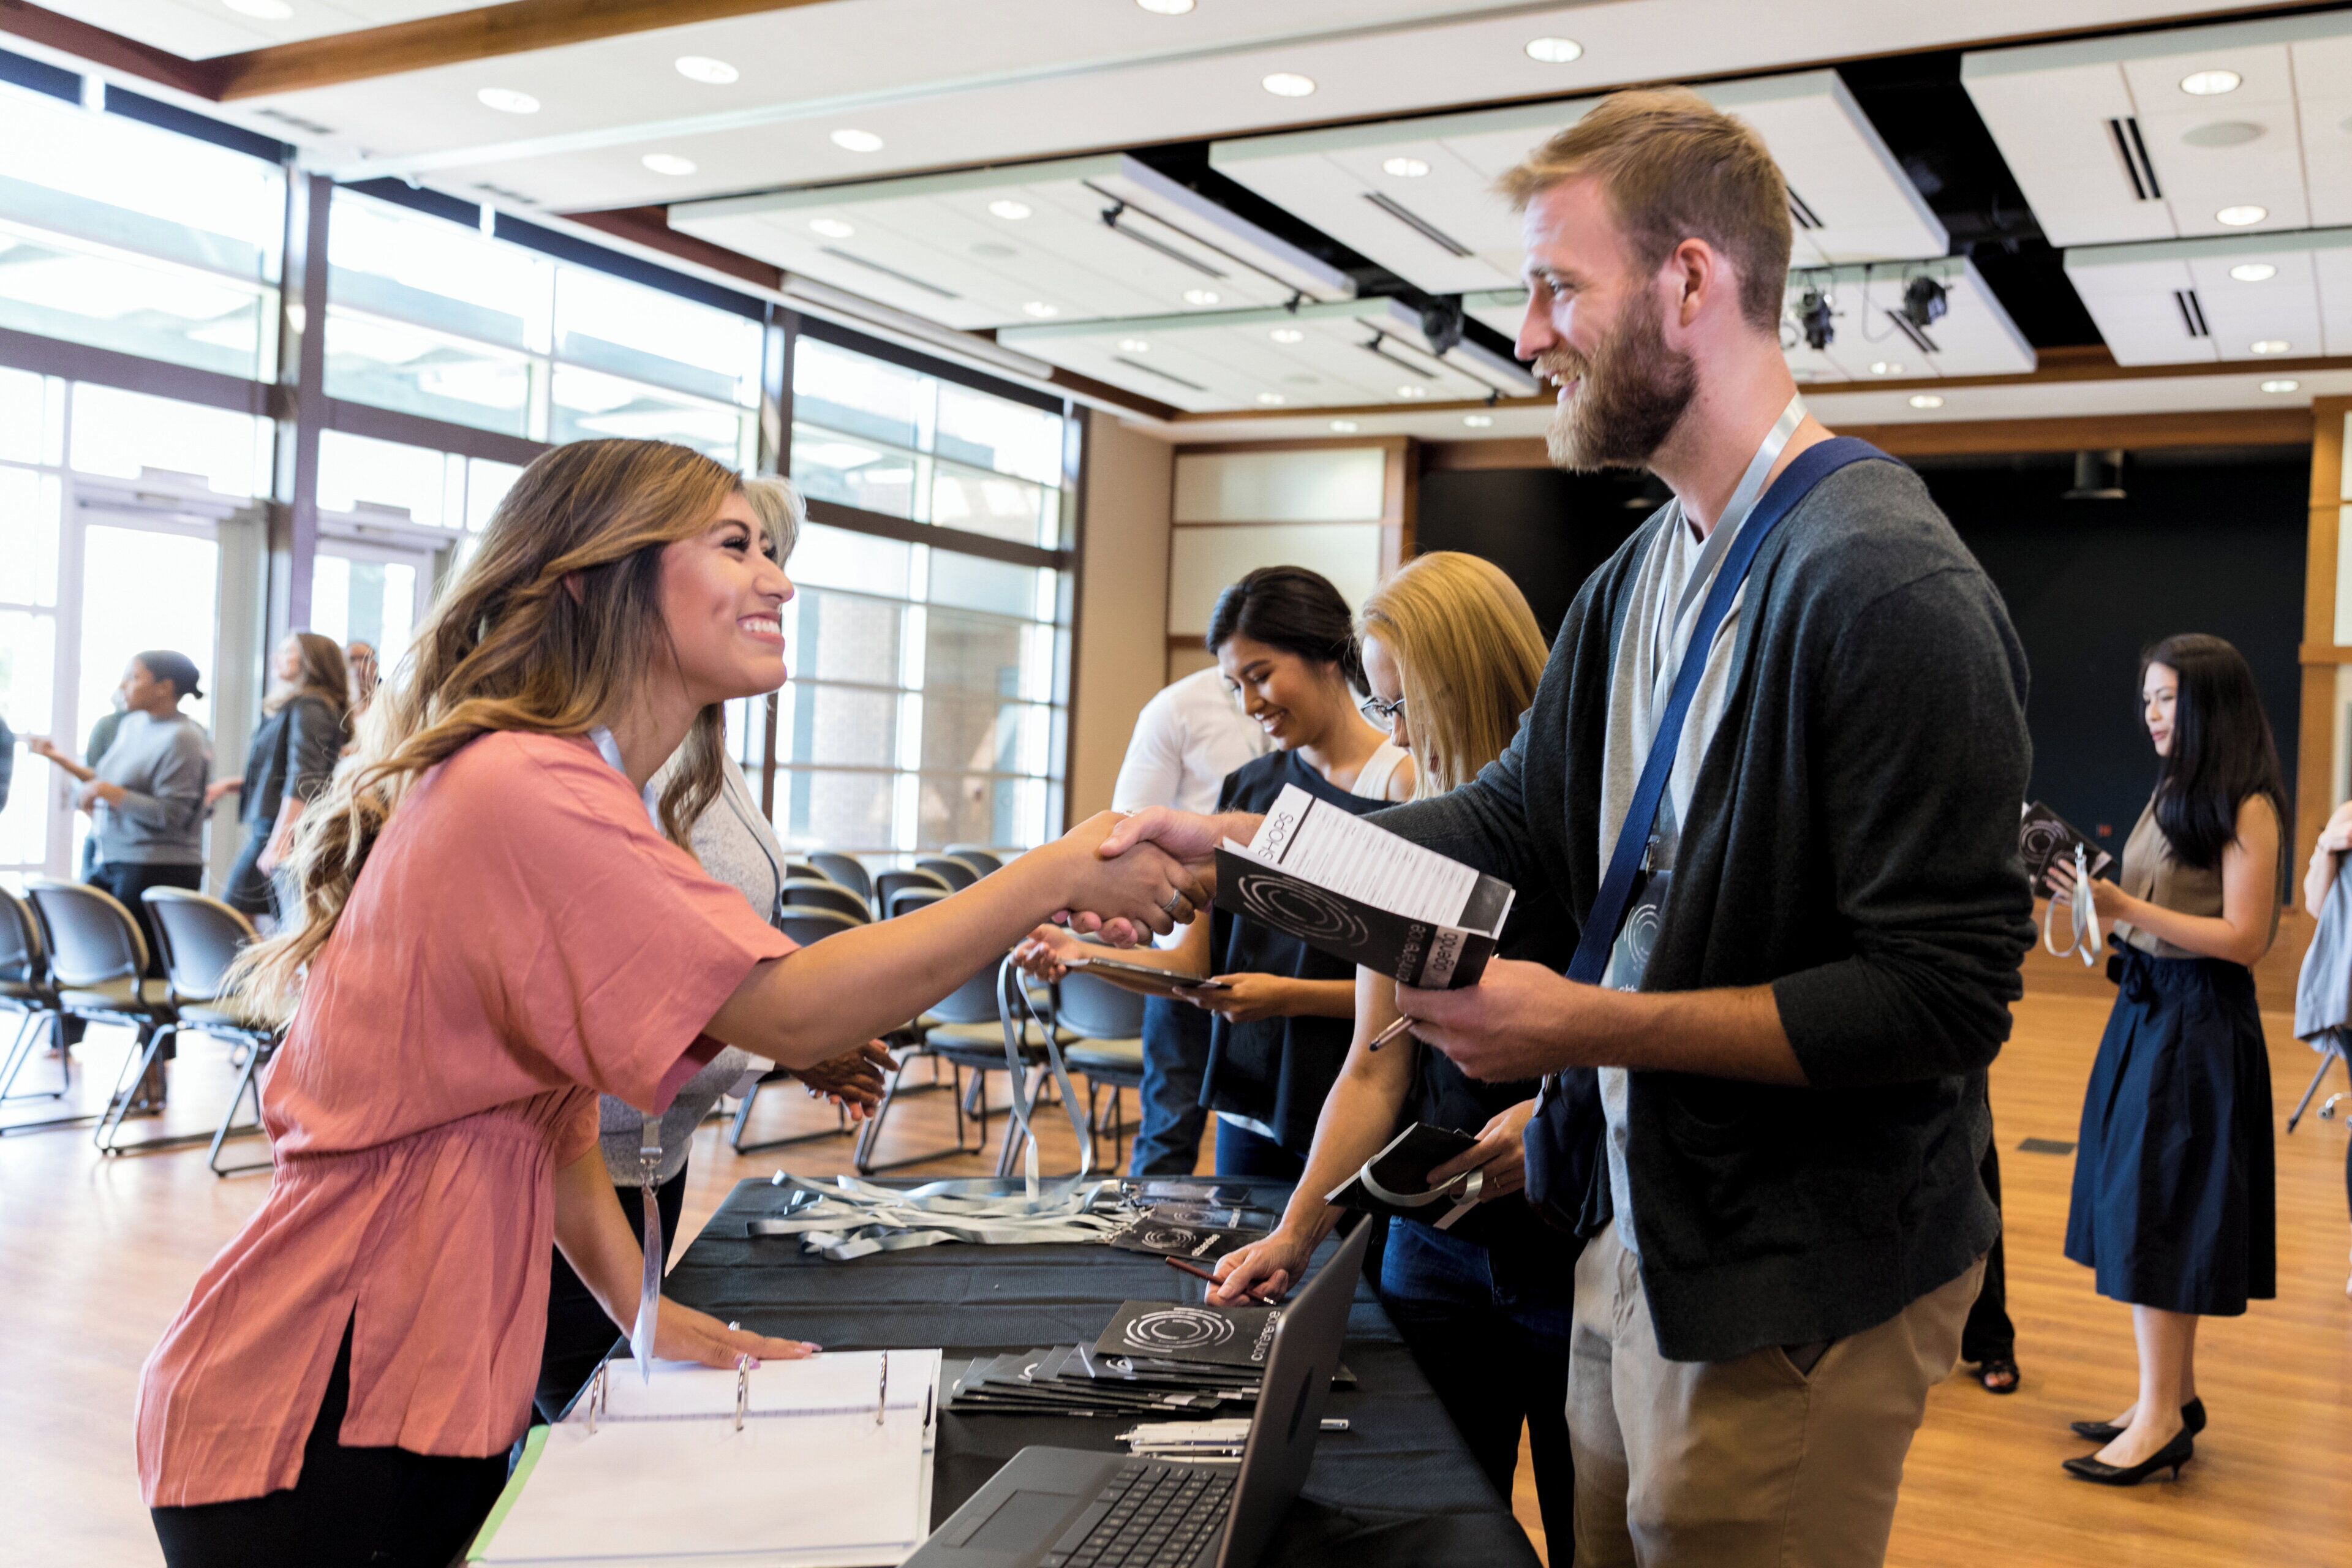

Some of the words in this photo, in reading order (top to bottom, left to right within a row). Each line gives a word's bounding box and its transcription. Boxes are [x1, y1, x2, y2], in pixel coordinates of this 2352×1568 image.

[1258, 812, 1294, 860] SHOPS
[1395, 924, 1427, 982] conference
[1433, 933, 1458, 971] agenda
[1251, 1311, 1281, 1362] conference
